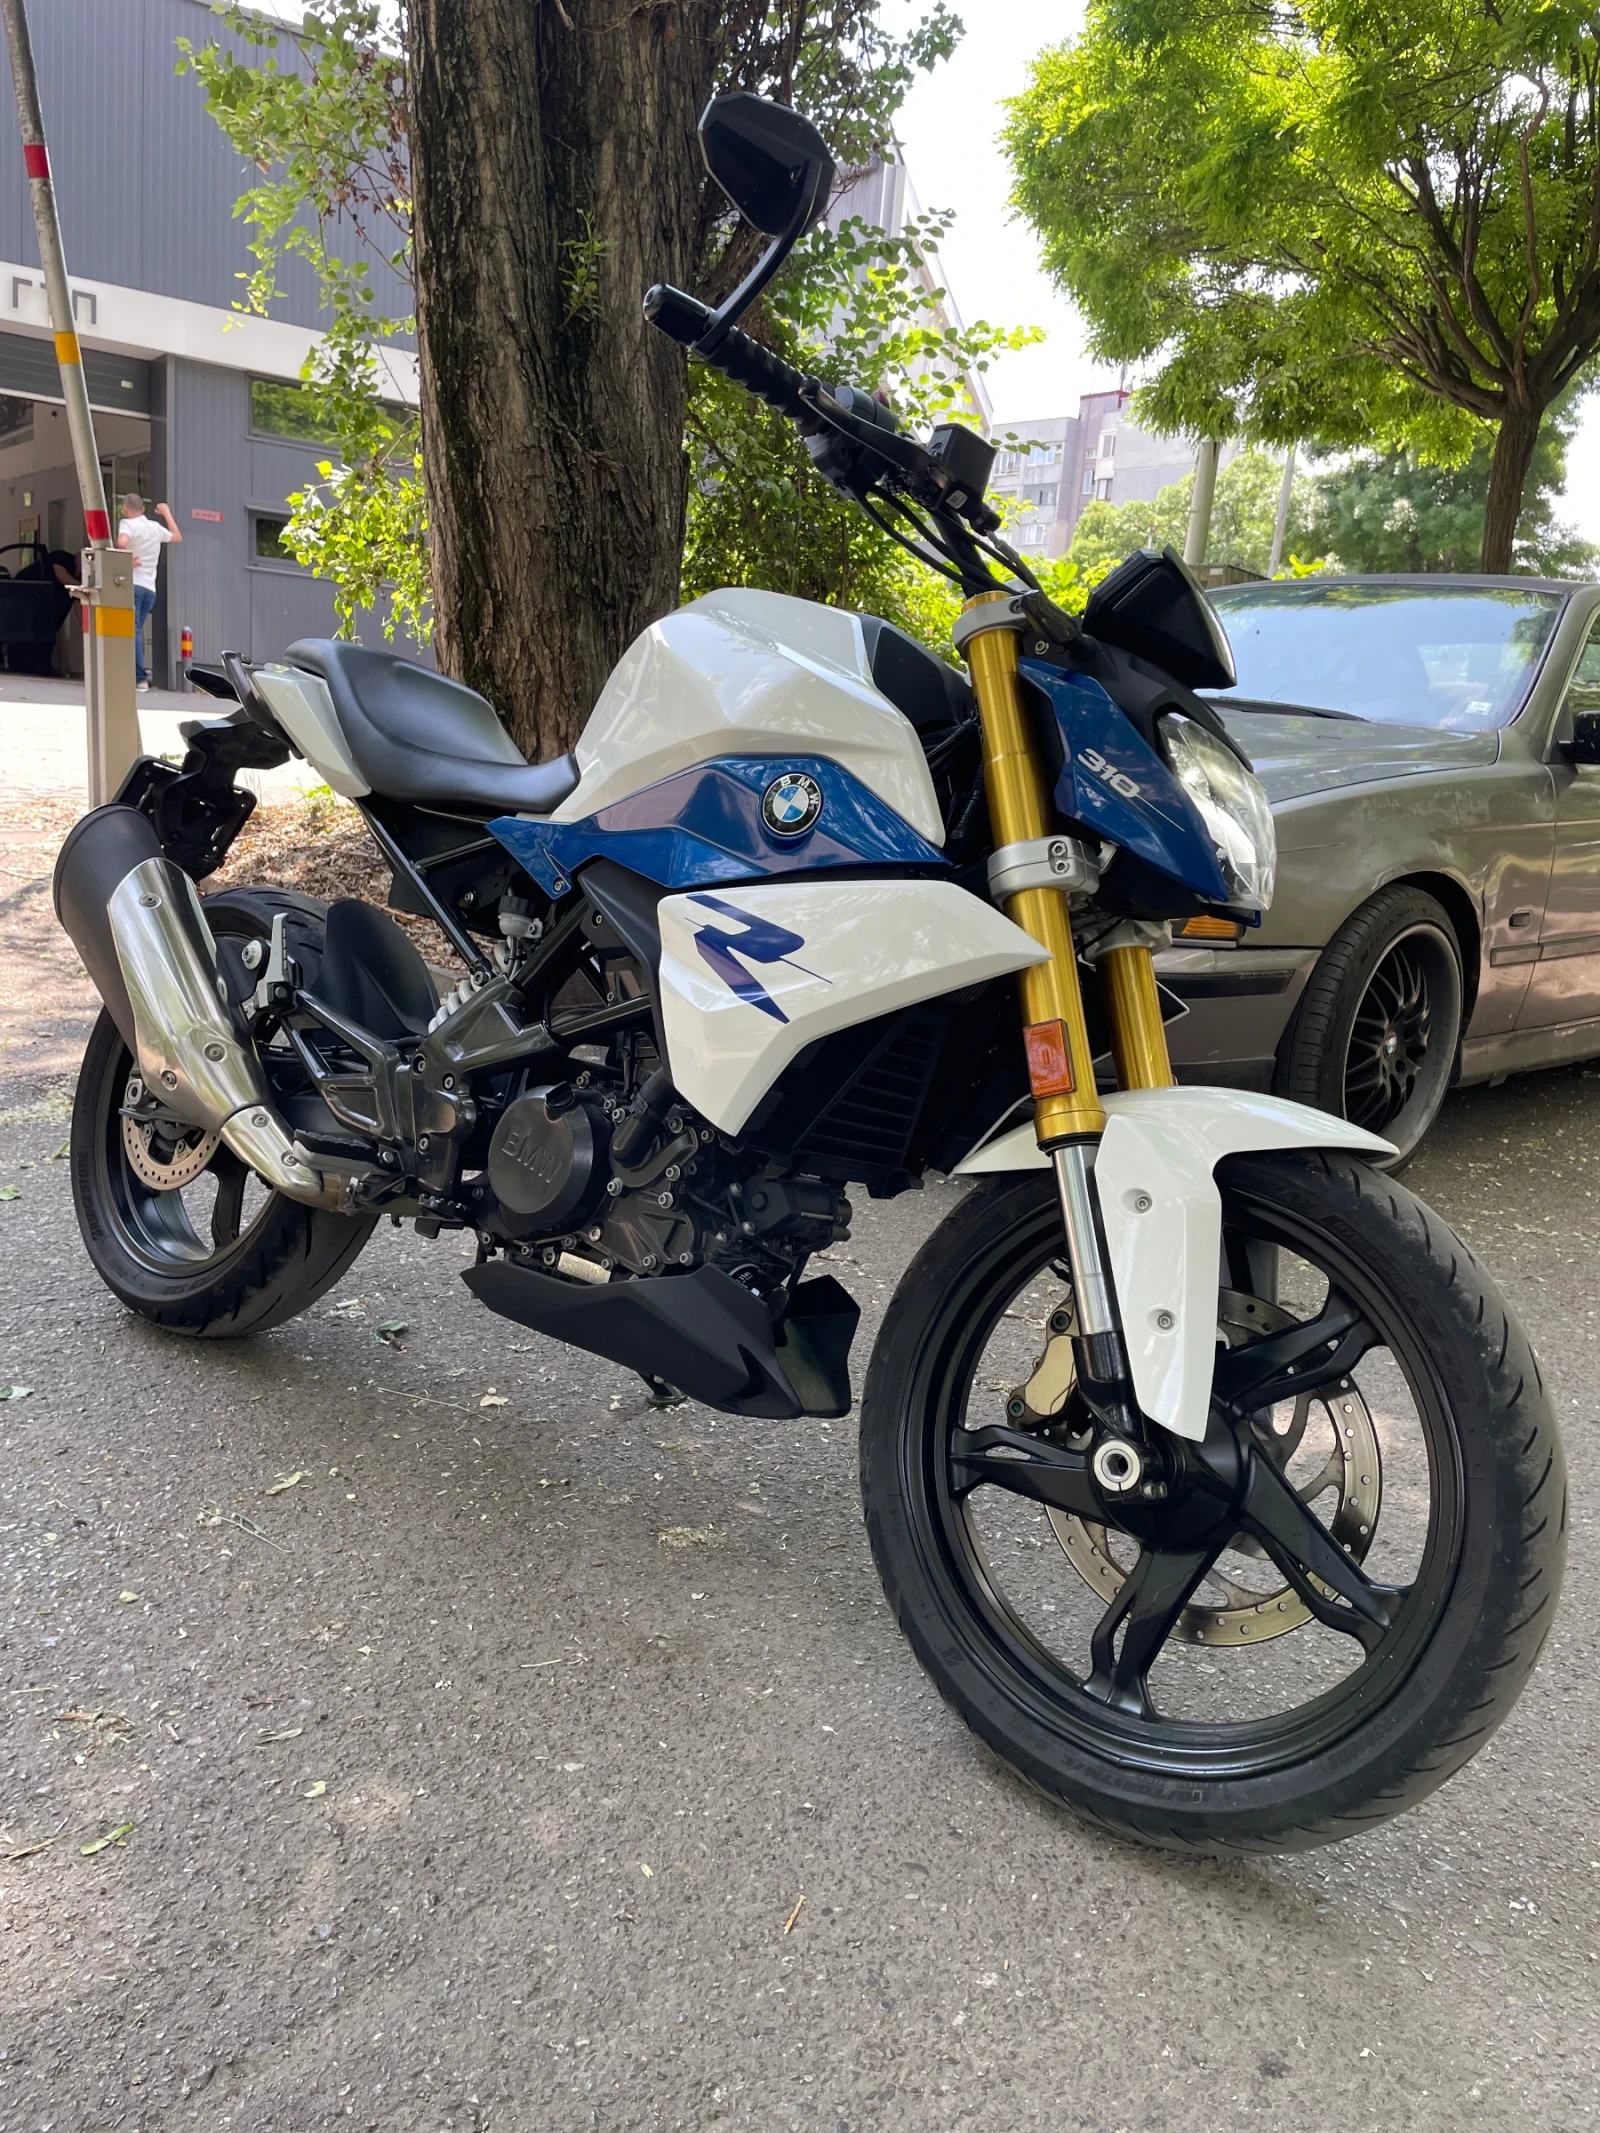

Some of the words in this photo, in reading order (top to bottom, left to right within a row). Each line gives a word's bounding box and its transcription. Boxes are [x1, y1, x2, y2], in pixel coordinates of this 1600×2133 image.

[12, 276, 97, 325] ГП
[780, 776, 819, 804] BMW
[1077, 748, 1140, 798] 310
[501, 1128, 563, 1184] BMW
[77, 1151, 105, 1241] BRIDGESTONE
